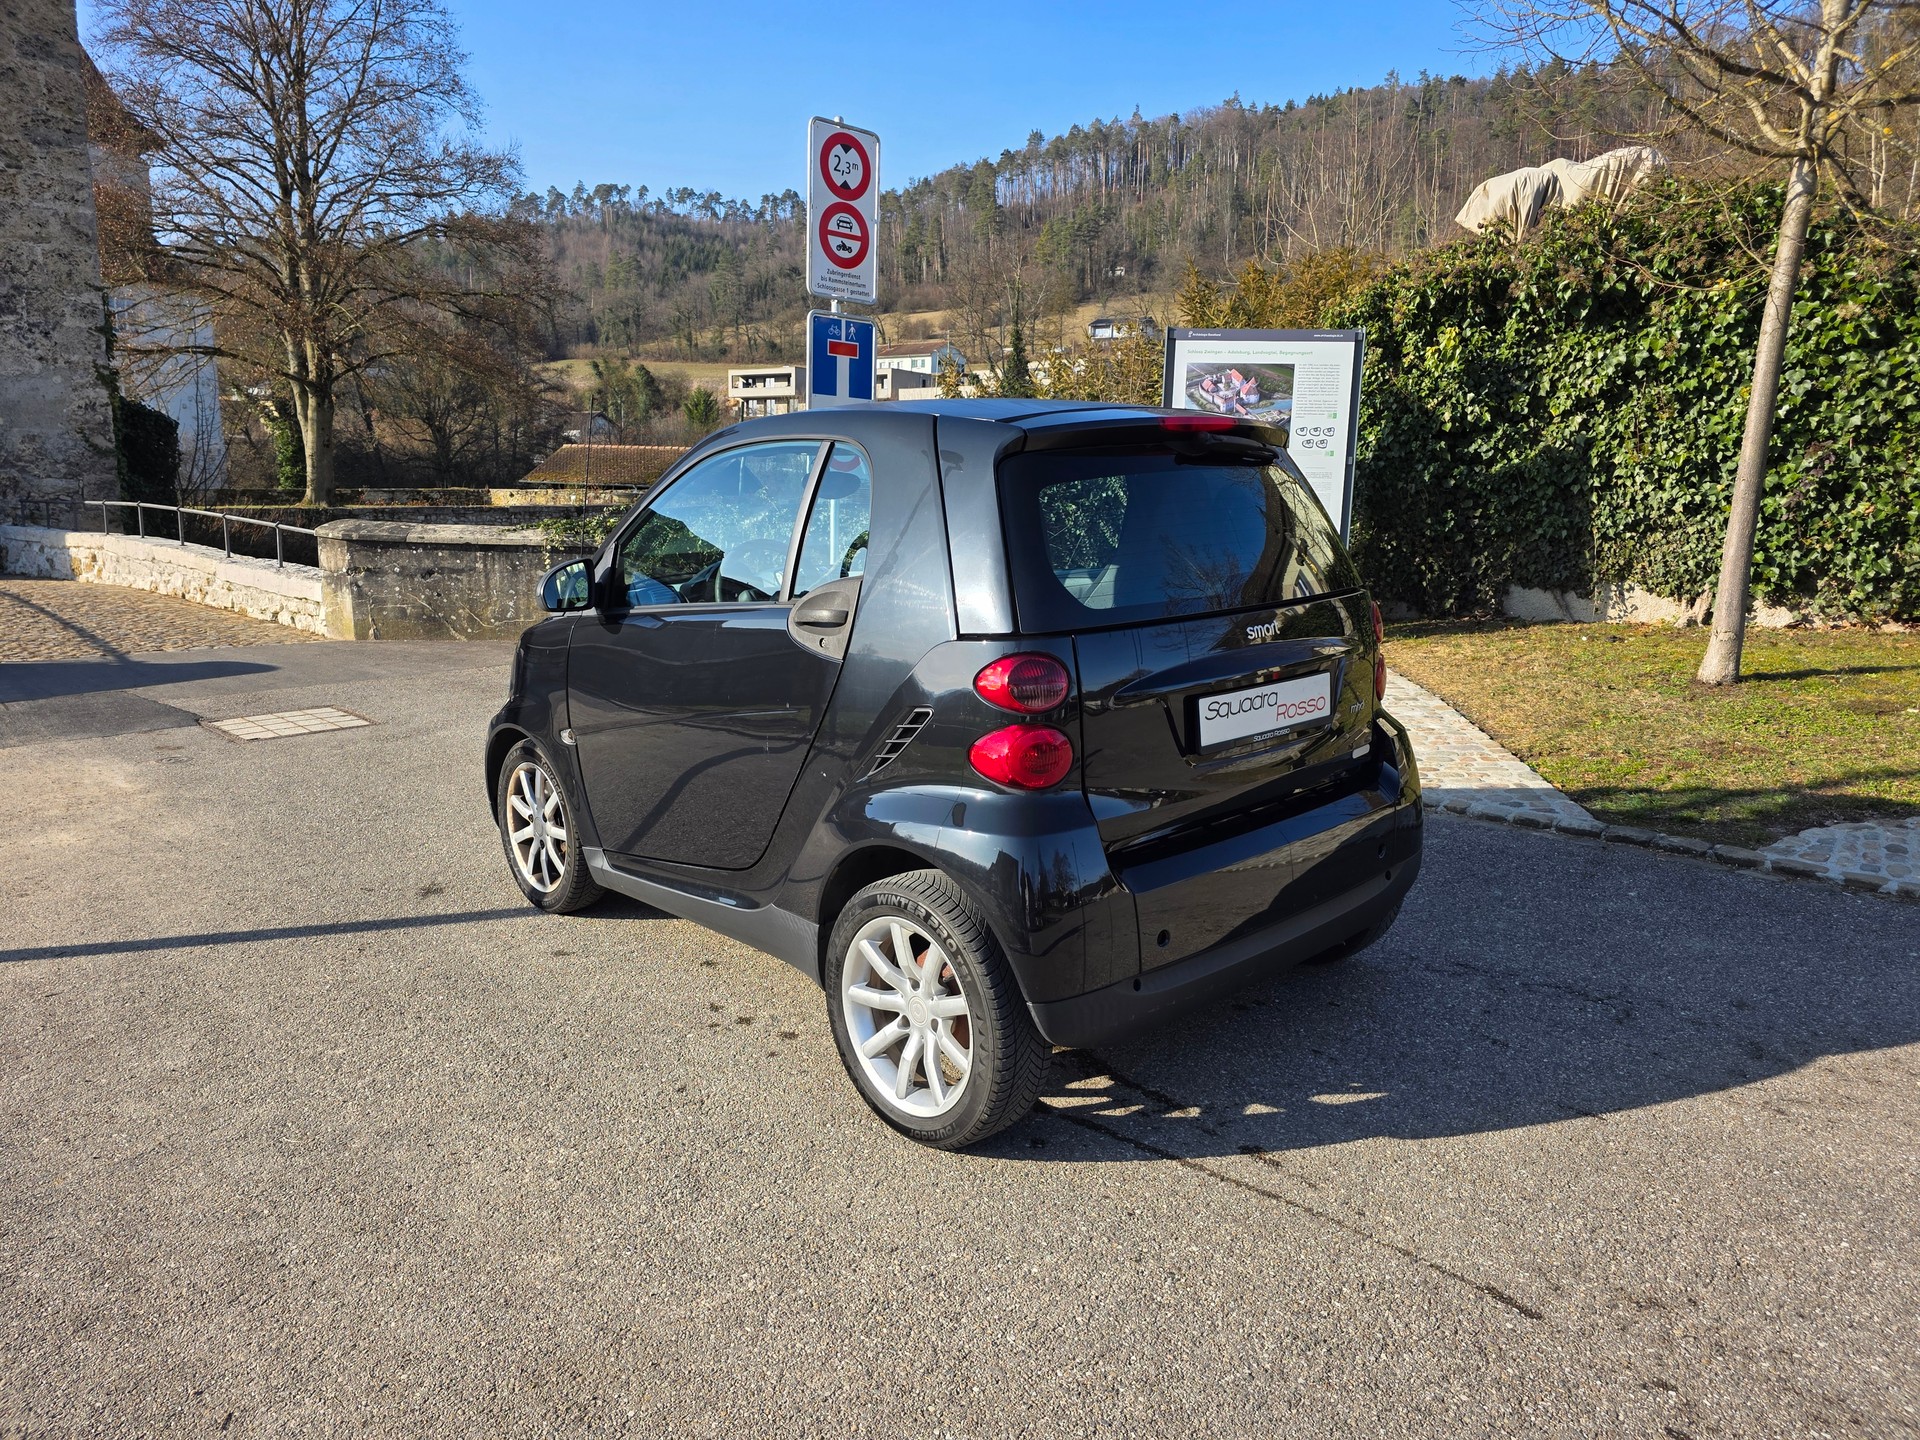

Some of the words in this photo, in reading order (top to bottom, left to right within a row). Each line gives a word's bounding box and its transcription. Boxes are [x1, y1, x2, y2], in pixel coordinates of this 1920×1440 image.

[826, 268, 861, 280] Zubringerdienst
[816, 282, 846, 293] Schlossgasse
[1246, 620, 1280, 640] smart
[1204, 691, 1278, 720] Squadra
[1253, 731, 1274, 742] Squadra
[876, 894, 927, 920] WINTER
[927, 916, 957, 953] PRO
